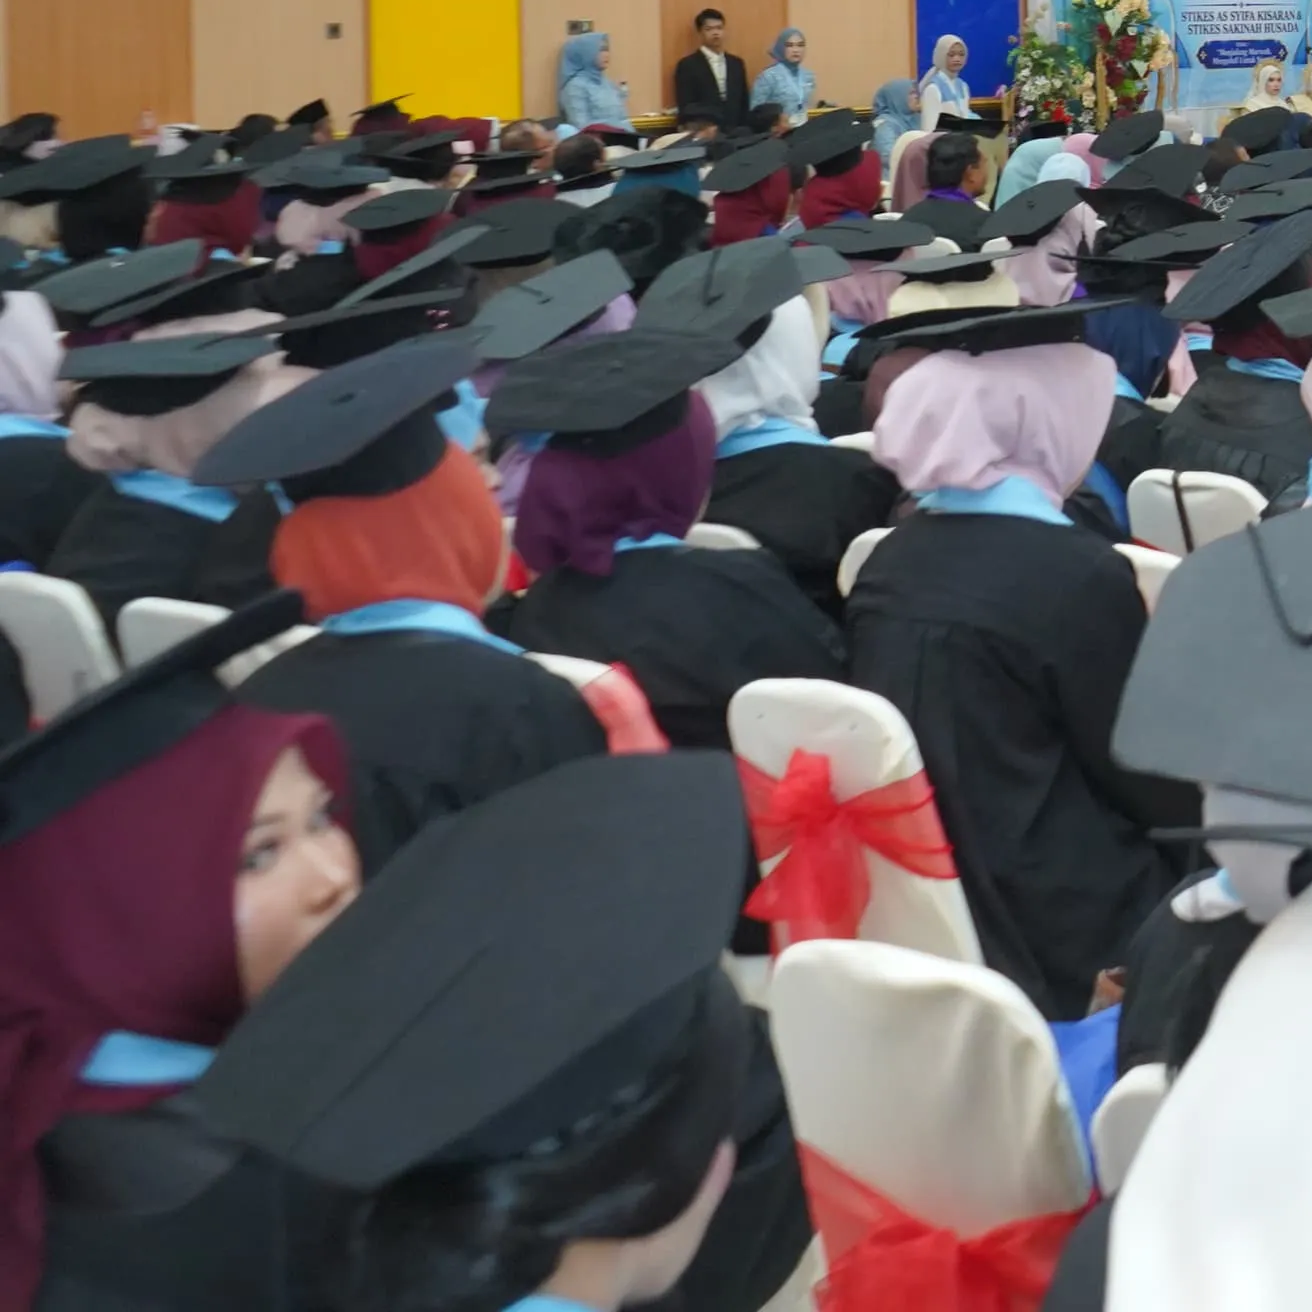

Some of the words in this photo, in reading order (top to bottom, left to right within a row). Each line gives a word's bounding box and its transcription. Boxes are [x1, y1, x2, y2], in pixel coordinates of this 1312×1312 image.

[1181, 11, 1215, 22] STIKES
[1216, 11, 1228, 21] AS
[1230, 10, 1255, 21] SYIFA
[1257, 10, 1295, 21] KISARAN
[1188, 24, 1221, 35] STIKES
[1223, 23, 1262, 34] SAKINAH
[1264, 22, 1299, 33] HUSADA
